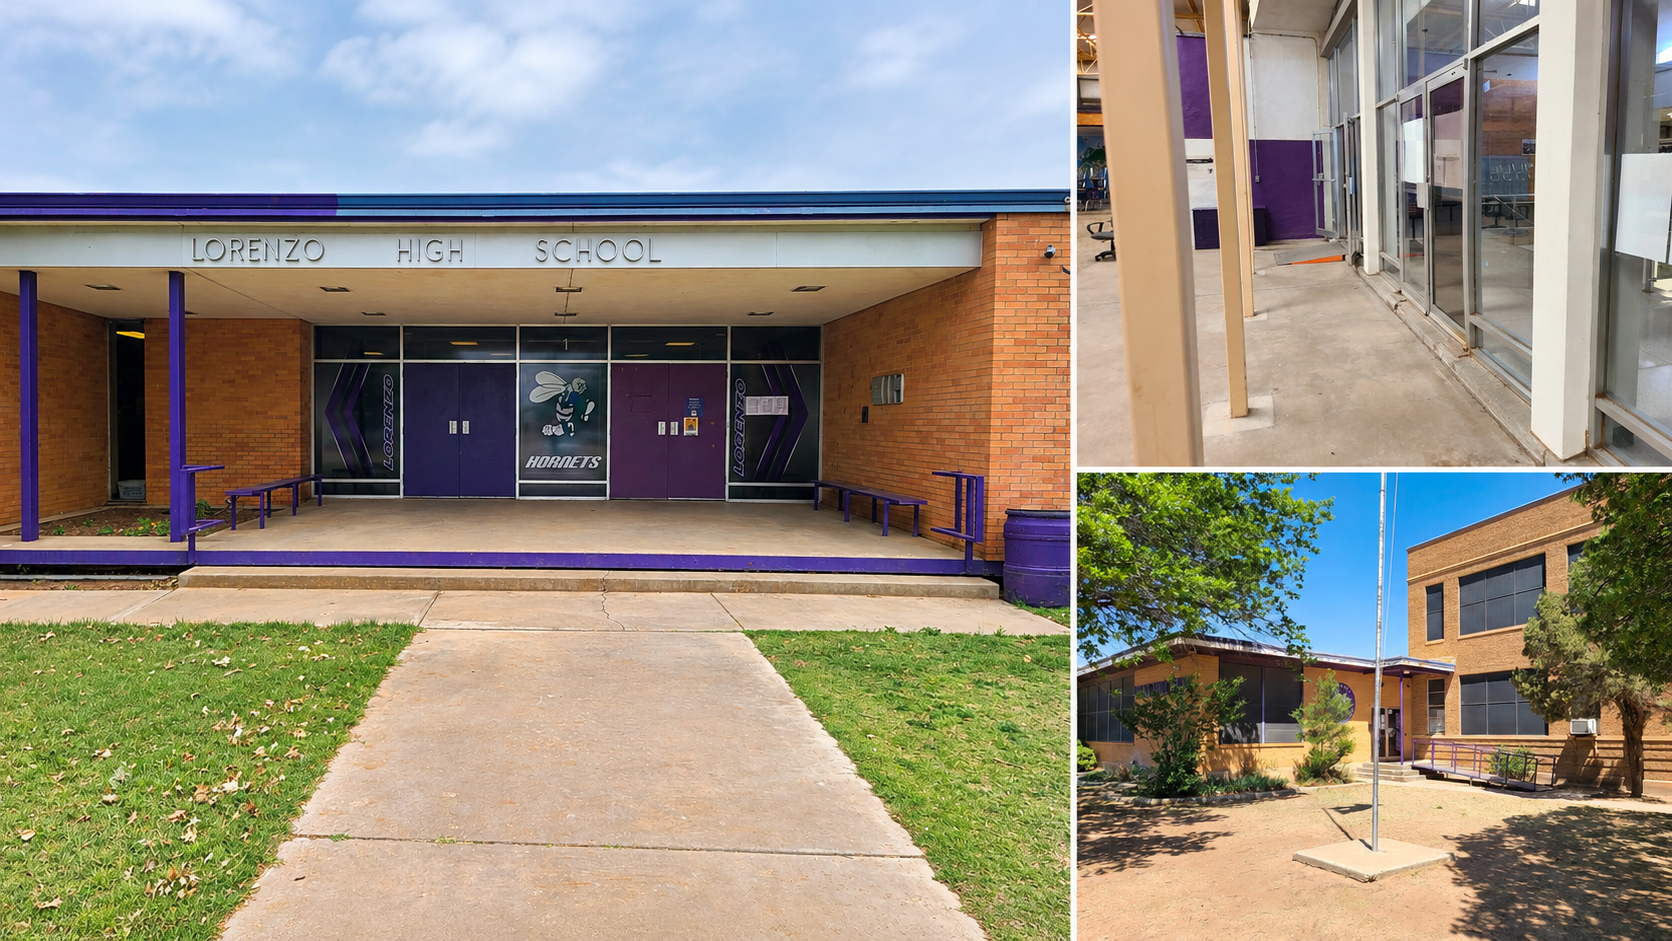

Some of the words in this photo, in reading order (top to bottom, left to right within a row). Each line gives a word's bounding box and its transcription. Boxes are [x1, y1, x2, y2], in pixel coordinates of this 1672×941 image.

[191, 237, 325, 262] LORENZO
[397, 238, 463, 262] HIGH
[535, 238, 662, 262] SCHOOL
[562, 338, 569, 351] 1
[383, 373, 394, 471] LORENZO
[525, 455, 602, 469] HORNETS
